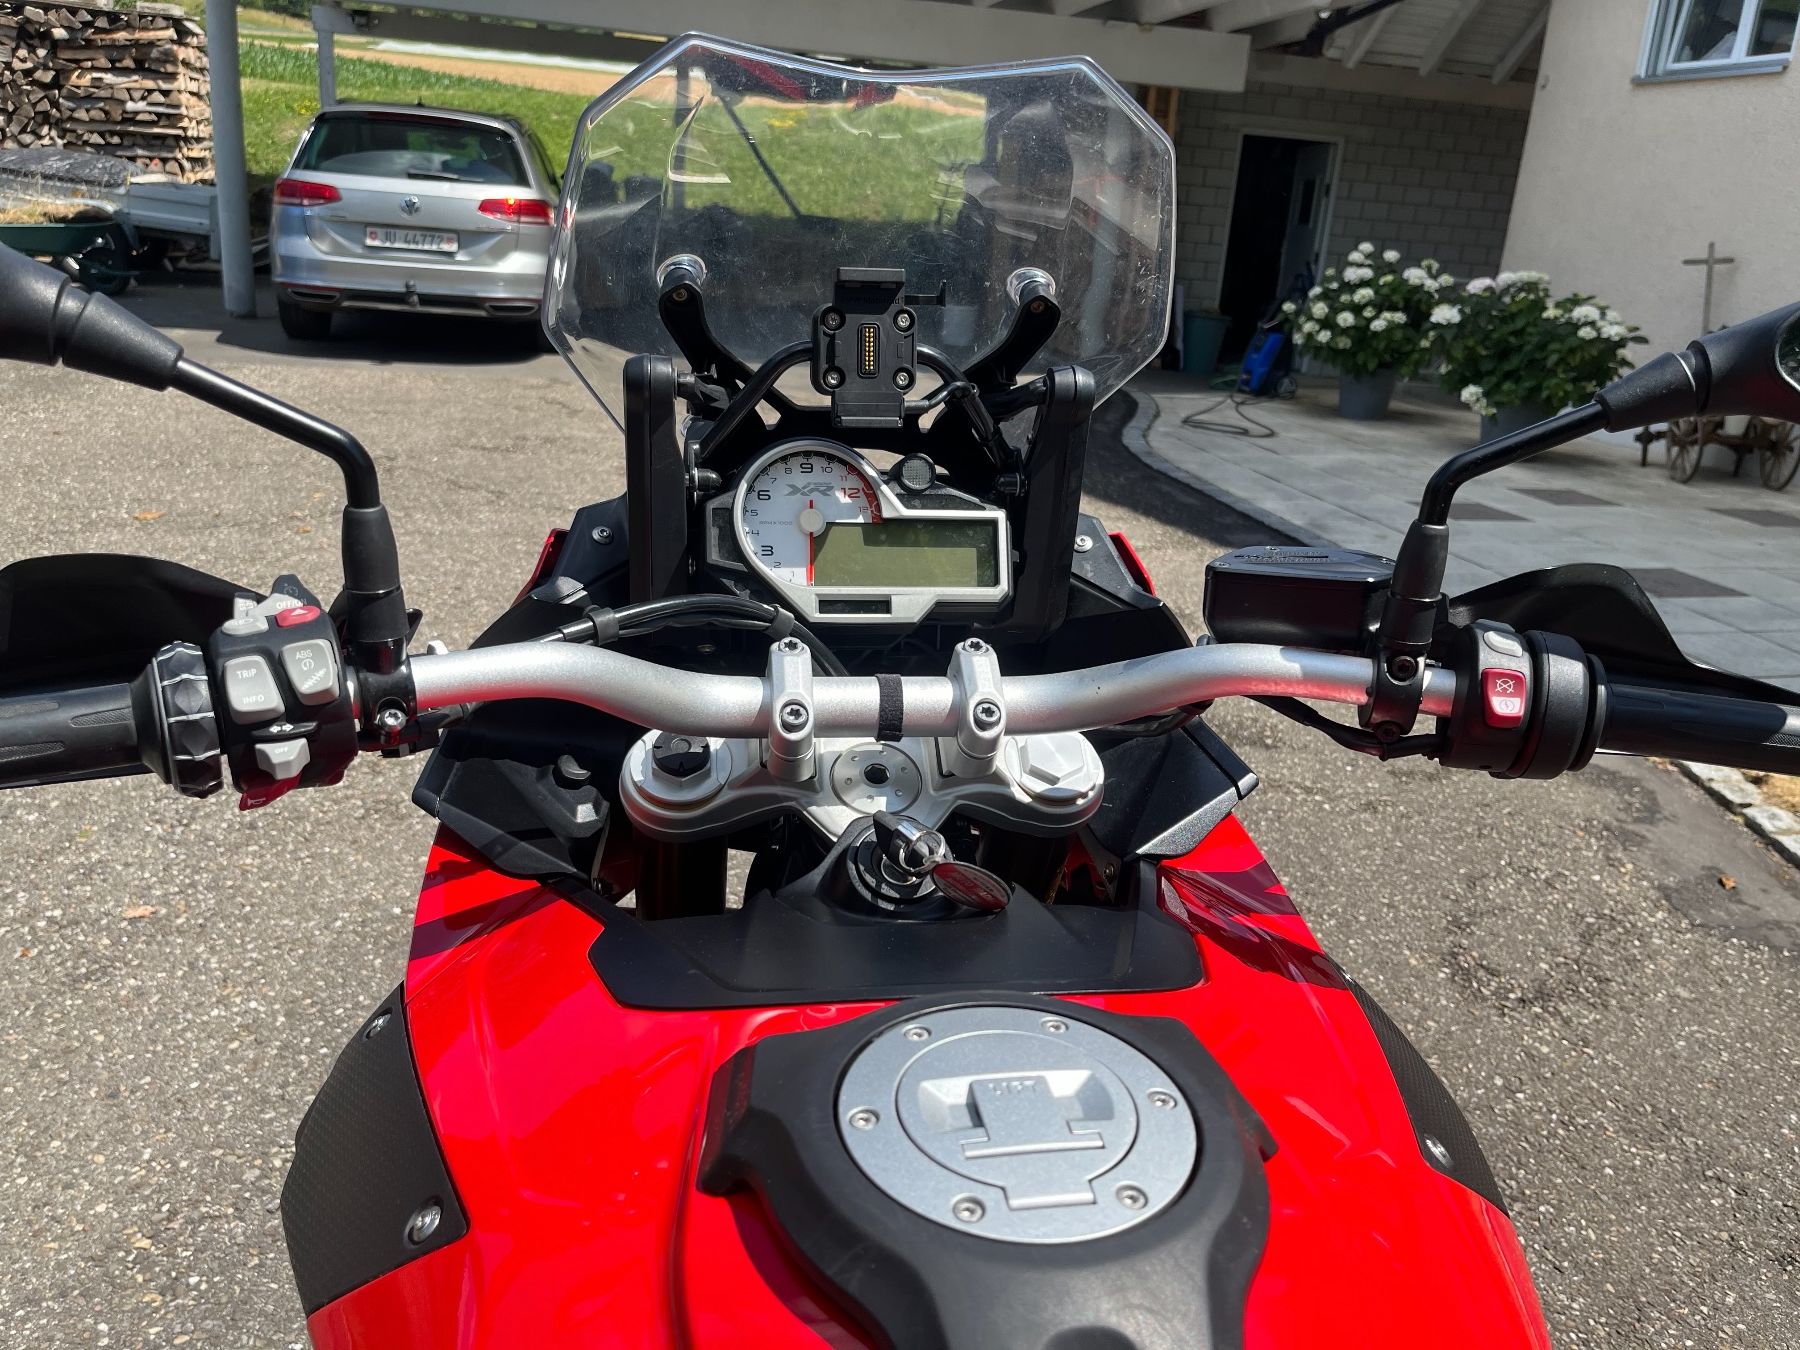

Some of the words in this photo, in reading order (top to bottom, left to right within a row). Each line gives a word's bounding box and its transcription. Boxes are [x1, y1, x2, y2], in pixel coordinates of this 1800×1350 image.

[382, 229, 397, 244] JU
[800, 463, 813, 474] 9
[769, 477, 777, 485] 7
[757, 490, 771, 501] 6
[784, 483, 835, 497] XR
[840, 487, 861, 499] 12
[750, 509, 759, 517] 5
[761, 545, 774, 557] 3
[295, 649, 313, 660] ABS
[236, 668, 257, 679] TRIP
[243, 694, 265, 705] INFO
[274, 746, 289, 754] OFF
